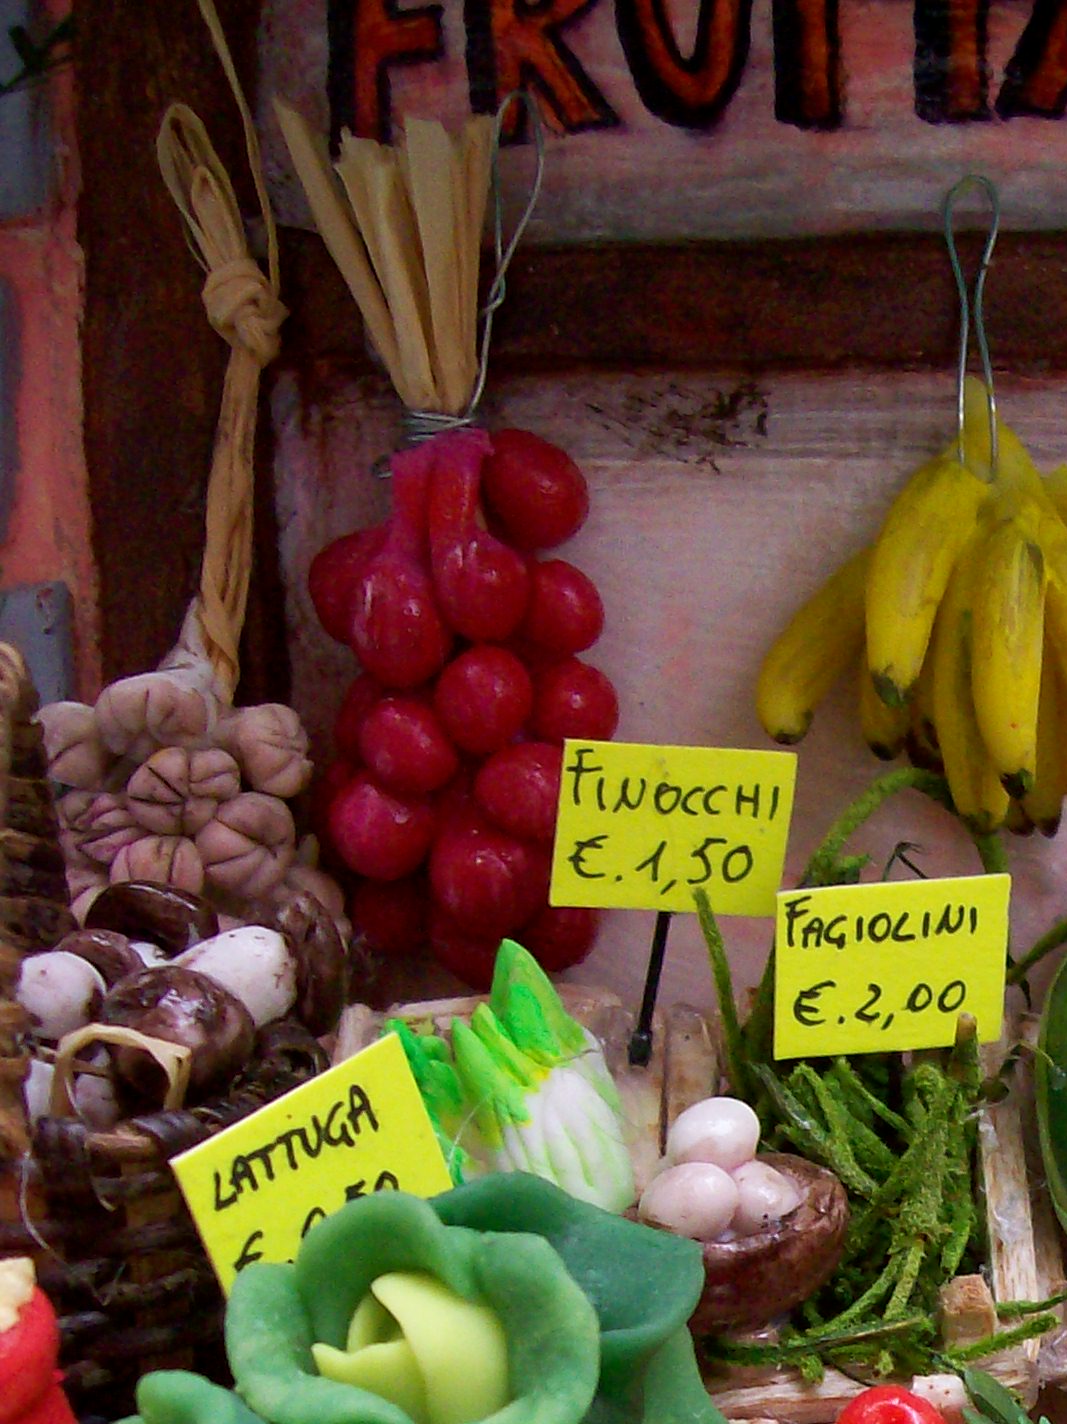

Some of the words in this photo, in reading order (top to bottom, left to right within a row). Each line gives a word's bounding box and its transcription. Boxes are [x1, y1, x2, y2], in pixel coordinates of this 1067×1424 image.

[566, 748, 780, 821] FINOCCHI
[784, 896, 979, 950] FAGIOLINI
[213, 1083, 379, 1212] LATTUGA
